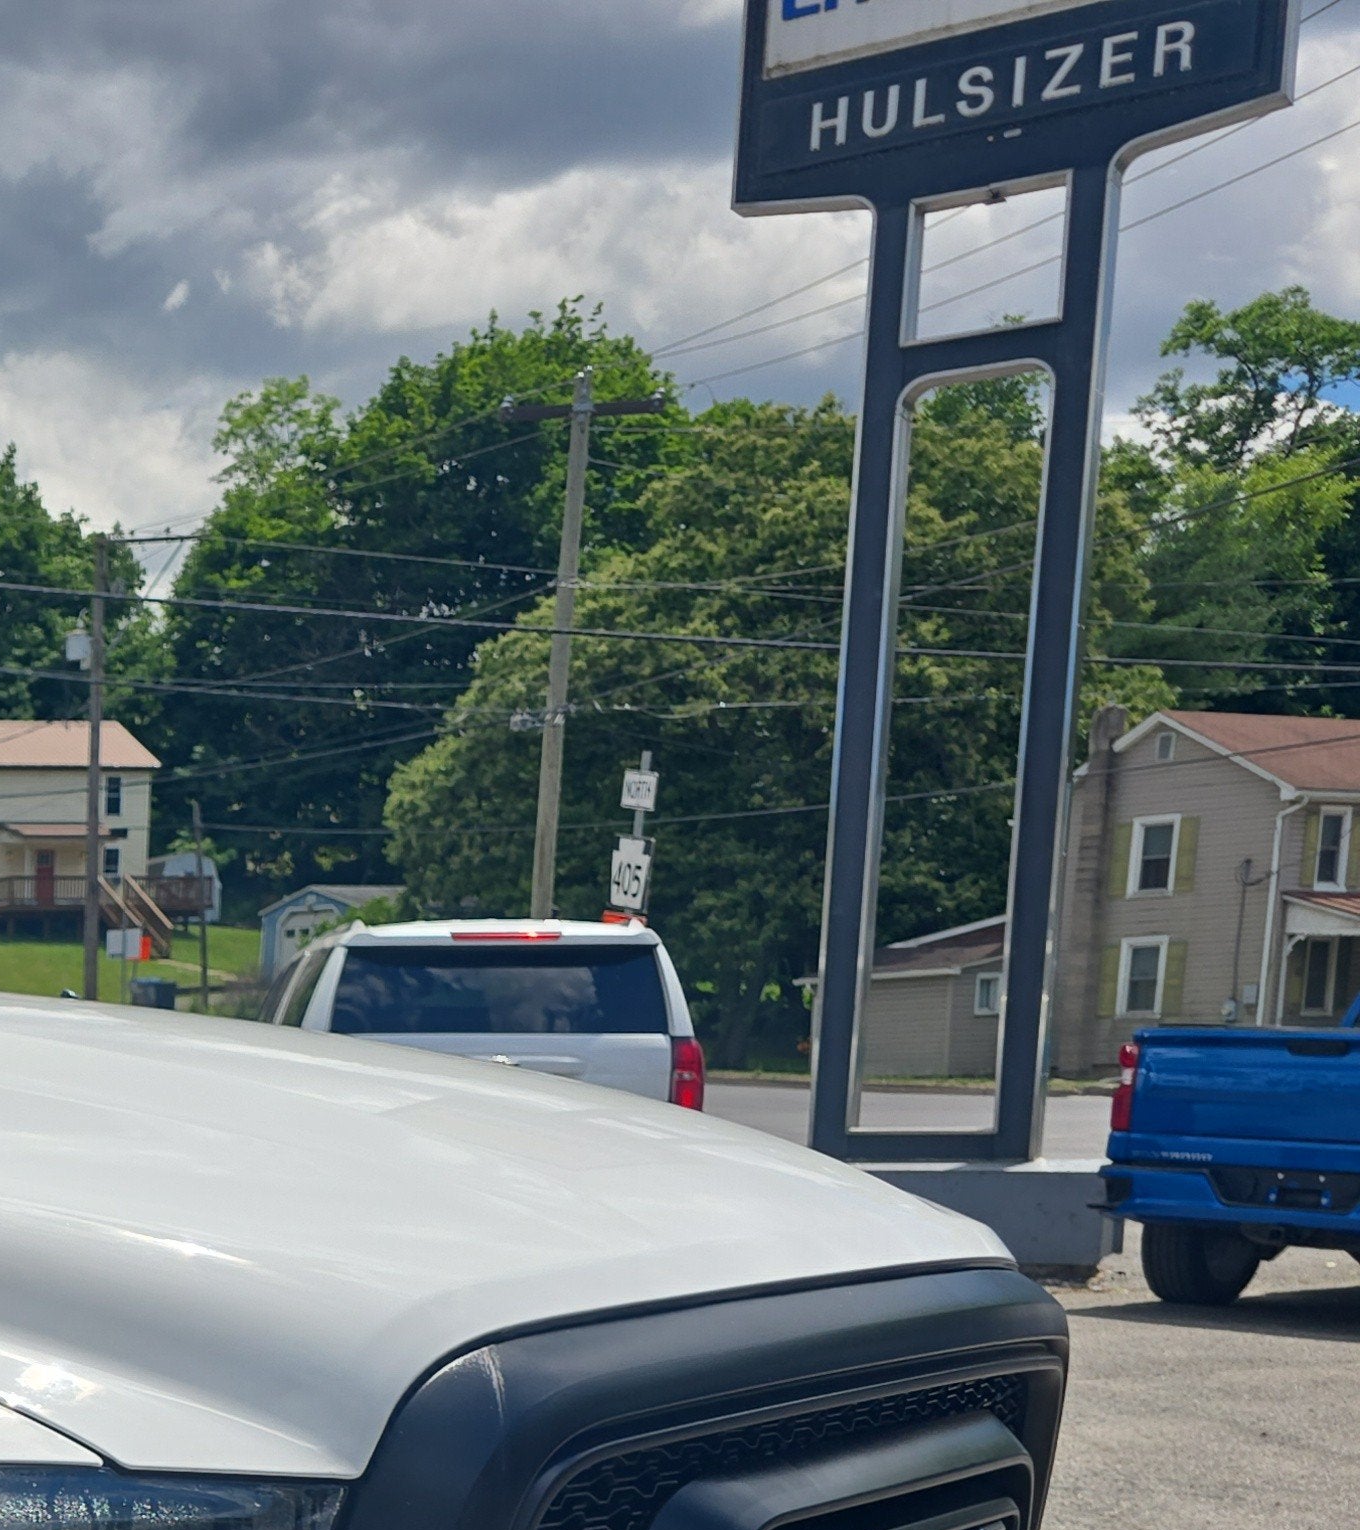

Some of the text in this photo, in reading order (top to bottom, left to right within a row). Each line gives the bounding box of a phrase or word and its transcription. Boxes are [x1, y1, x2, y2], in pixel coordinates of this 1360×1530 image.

[810, 20, 1195, 151] HULSIZER
[625, 780, 651, 799] NORTH
[613, 861, 642, 897] 405
